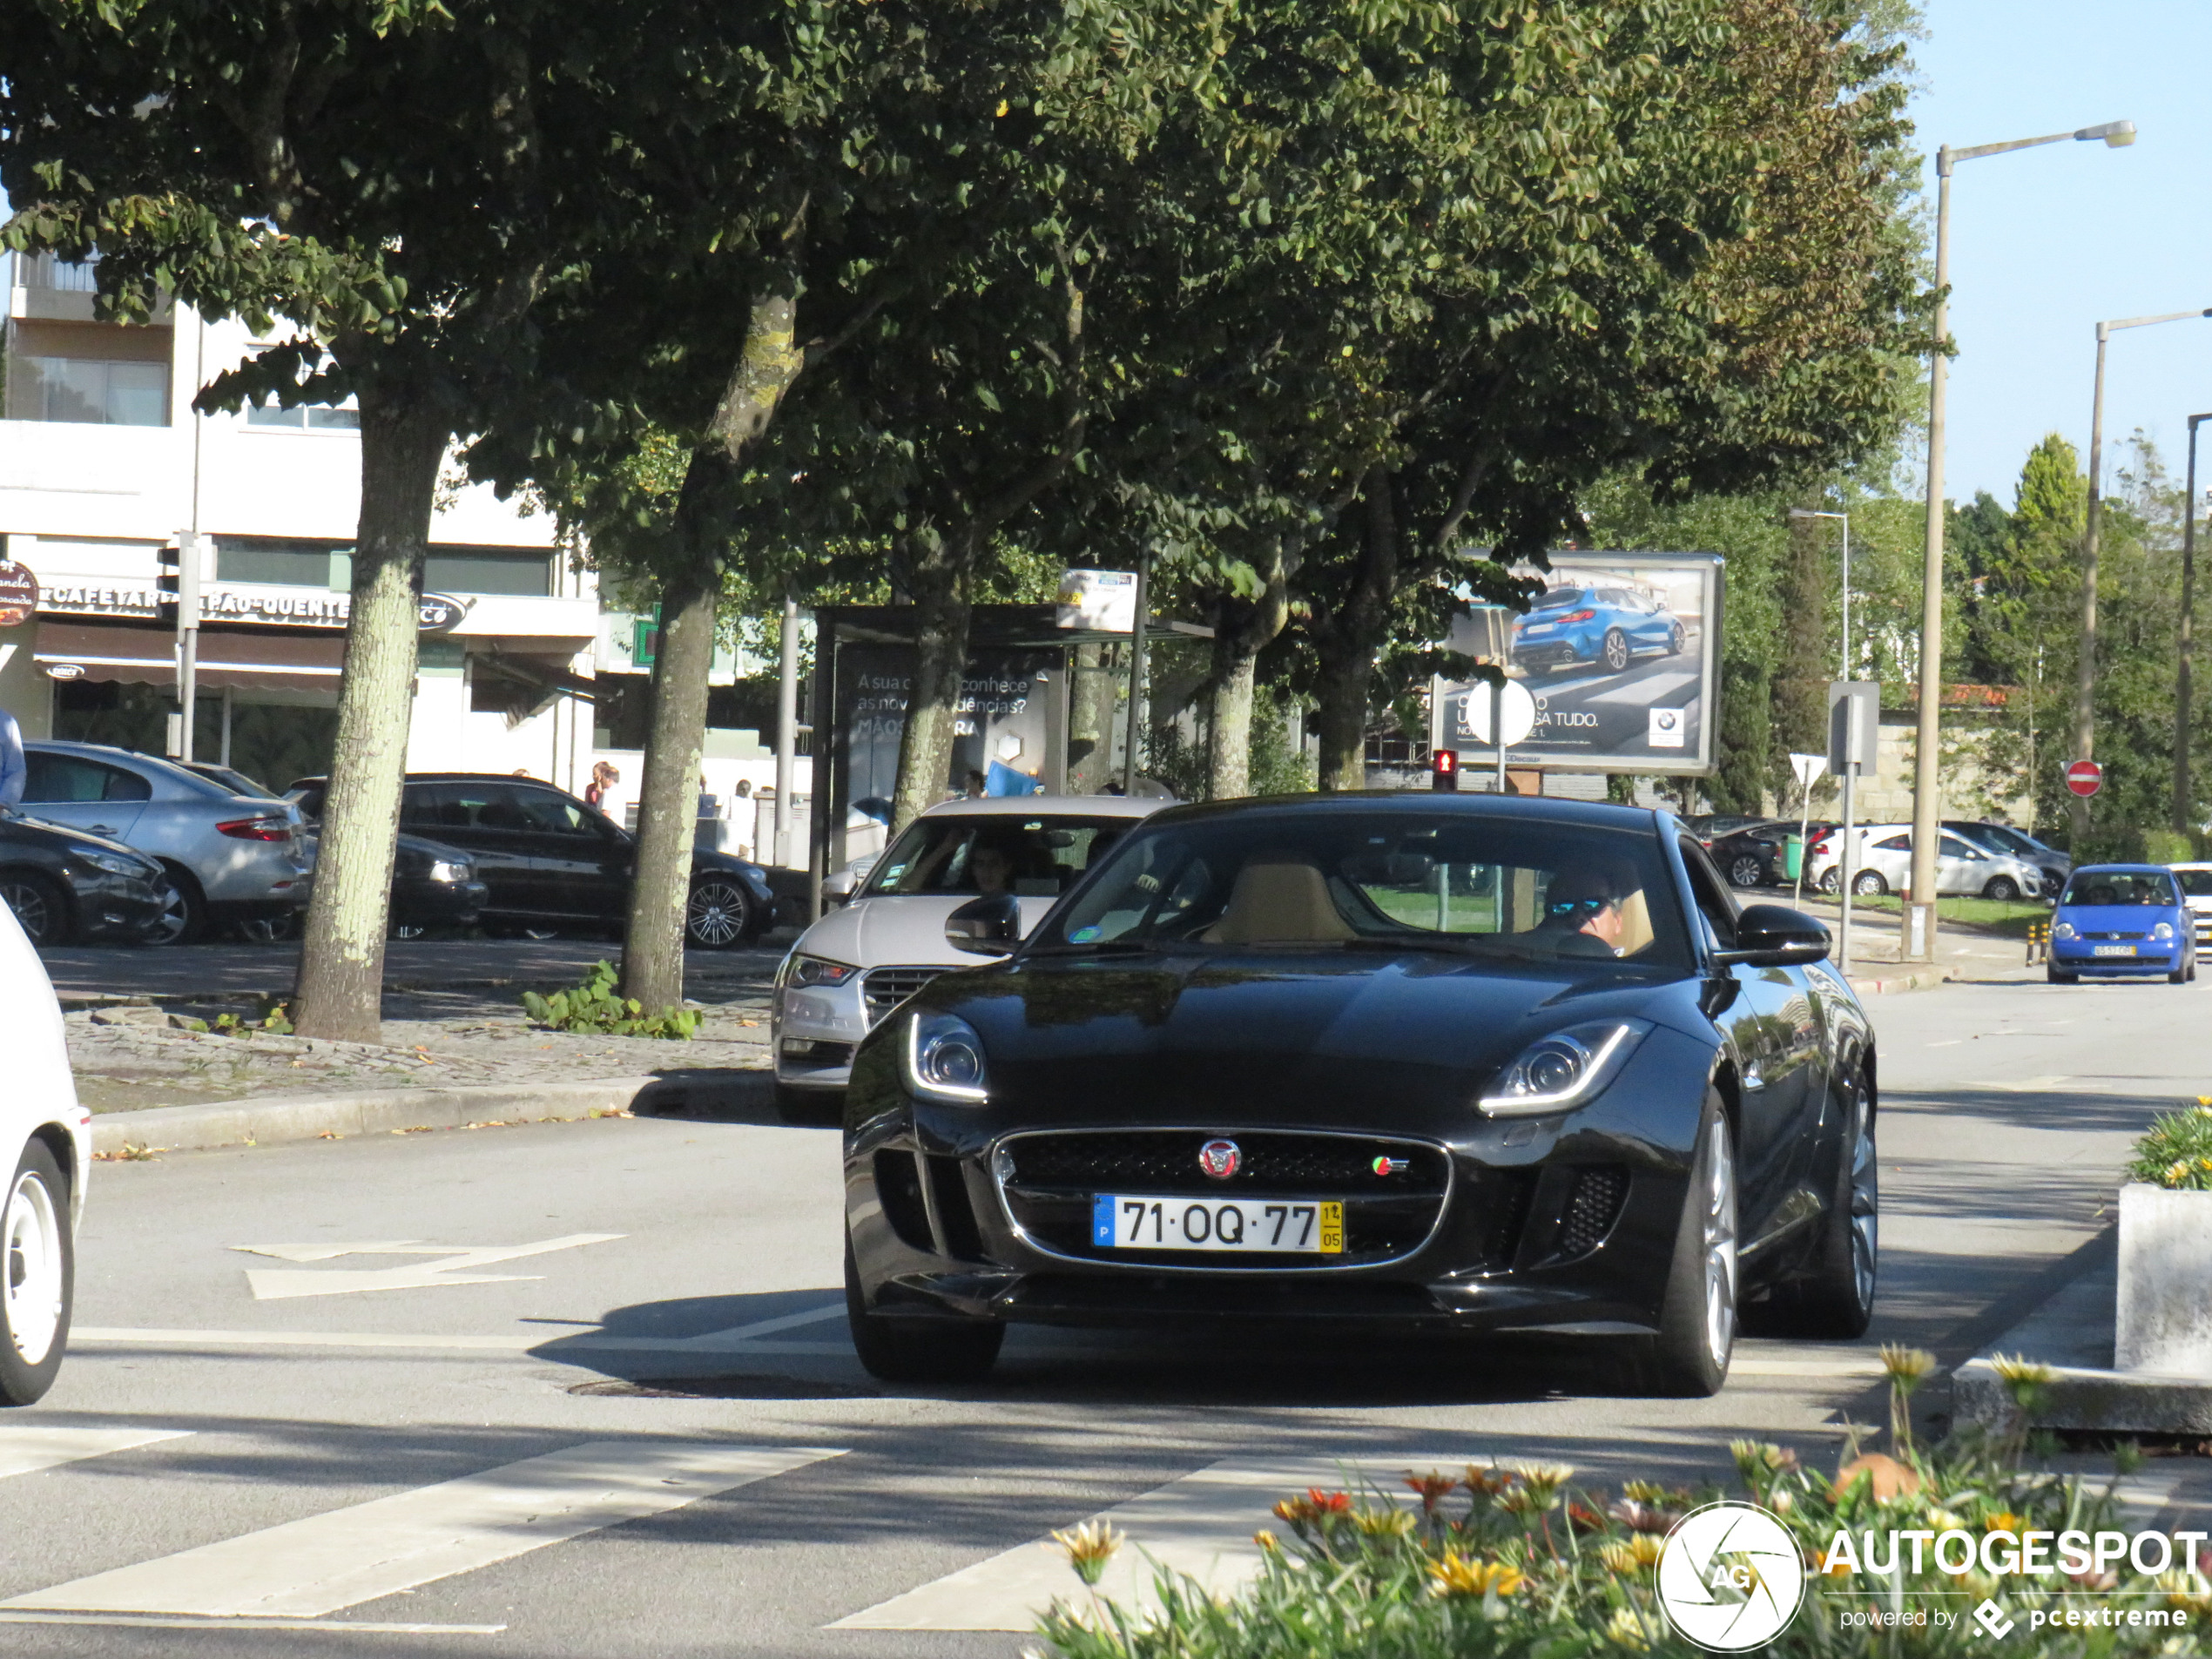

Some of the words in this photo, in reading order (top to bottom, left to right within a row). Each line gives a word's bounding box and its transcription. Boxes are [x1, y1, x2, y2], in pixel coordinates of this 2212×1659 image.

[858, 674, 869, 689] A
[873, 677, 899, 690] sua
[961, 677, 1028, 693] conhece
[858, 698, 876, 710] as
[1554, 712, 1599, 727] TUDO.
[1099, 1226, 1109, 1238] P
[1323, 1233, 1340, 1246] 05
